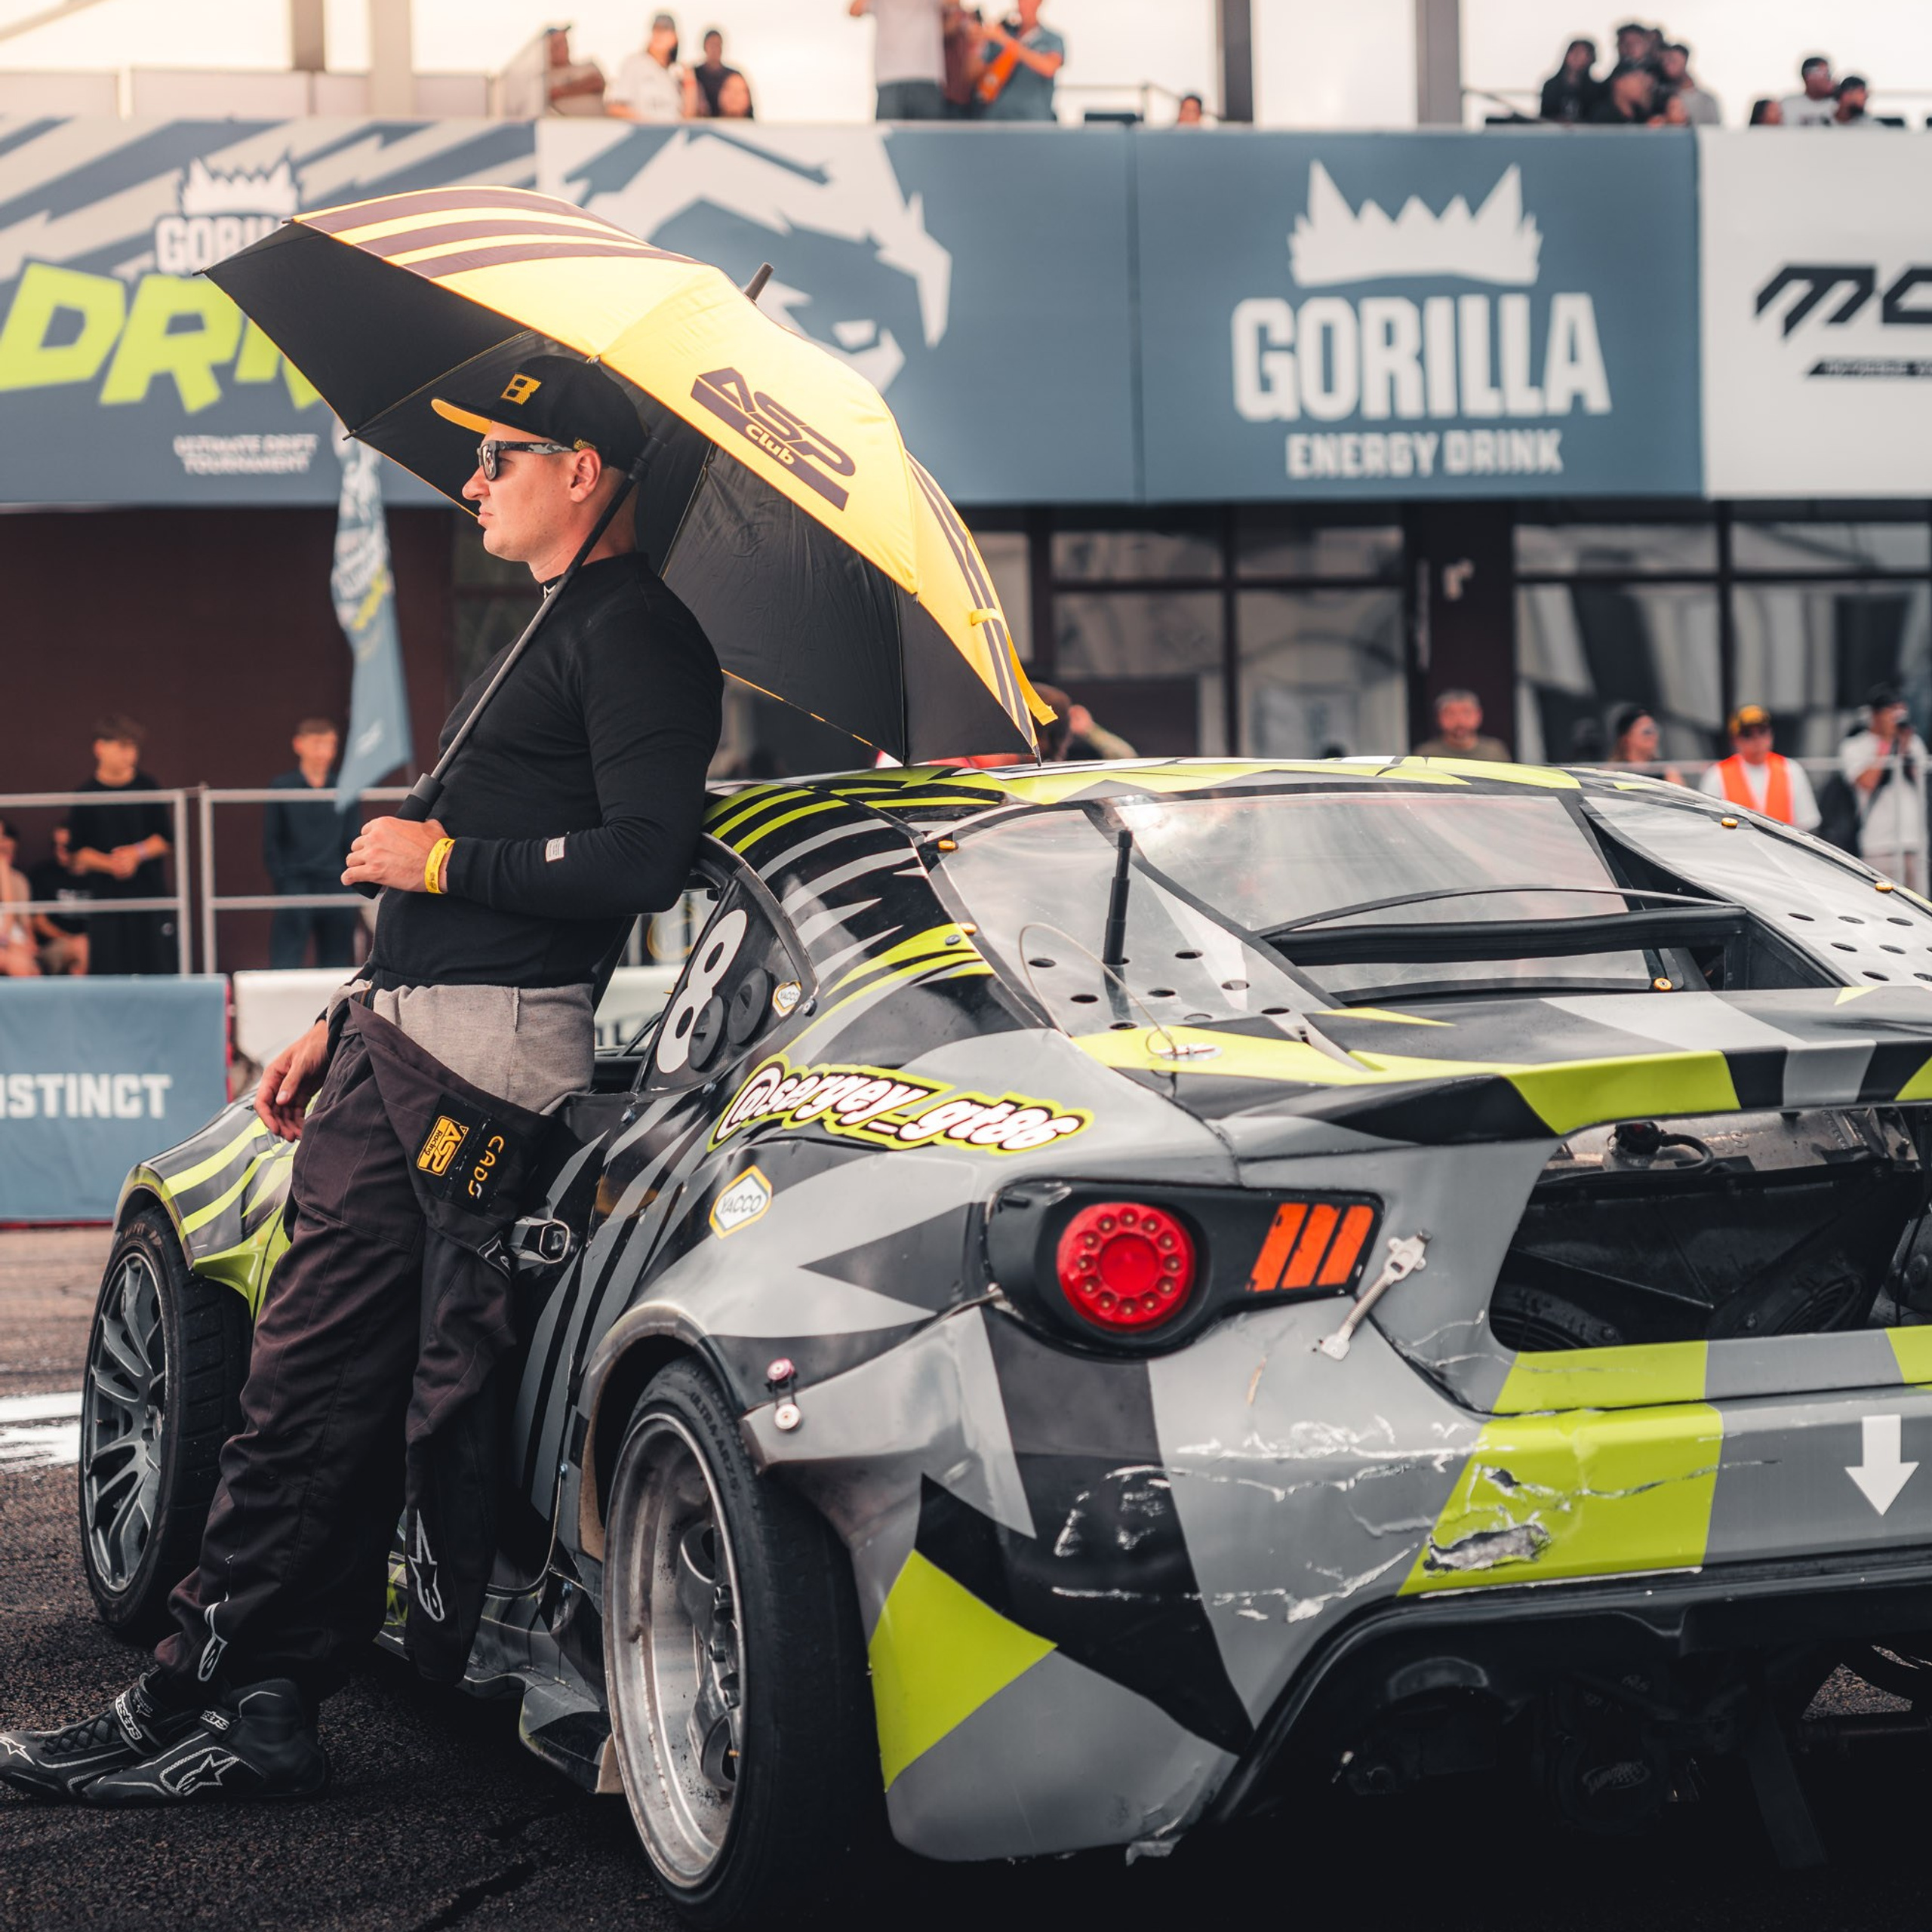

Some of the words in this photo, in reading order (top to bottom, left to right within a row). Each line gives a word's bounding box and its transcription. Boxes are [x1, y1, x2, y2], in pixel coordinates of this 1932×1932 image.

[1232, 293, 1613, 421] GORILLA
[697, 367, 856, 476] ASP
[1285, 432, 1439, 478] ENERGY
[1442, 427, 1564, 475] DRINK
[657, 909, 747, 1072] 8
[0, 1073, 173, 1119] STINCT
[424, 1129, 444, 1157] Racing
[719, 1193, 762, 1215] YACCO
